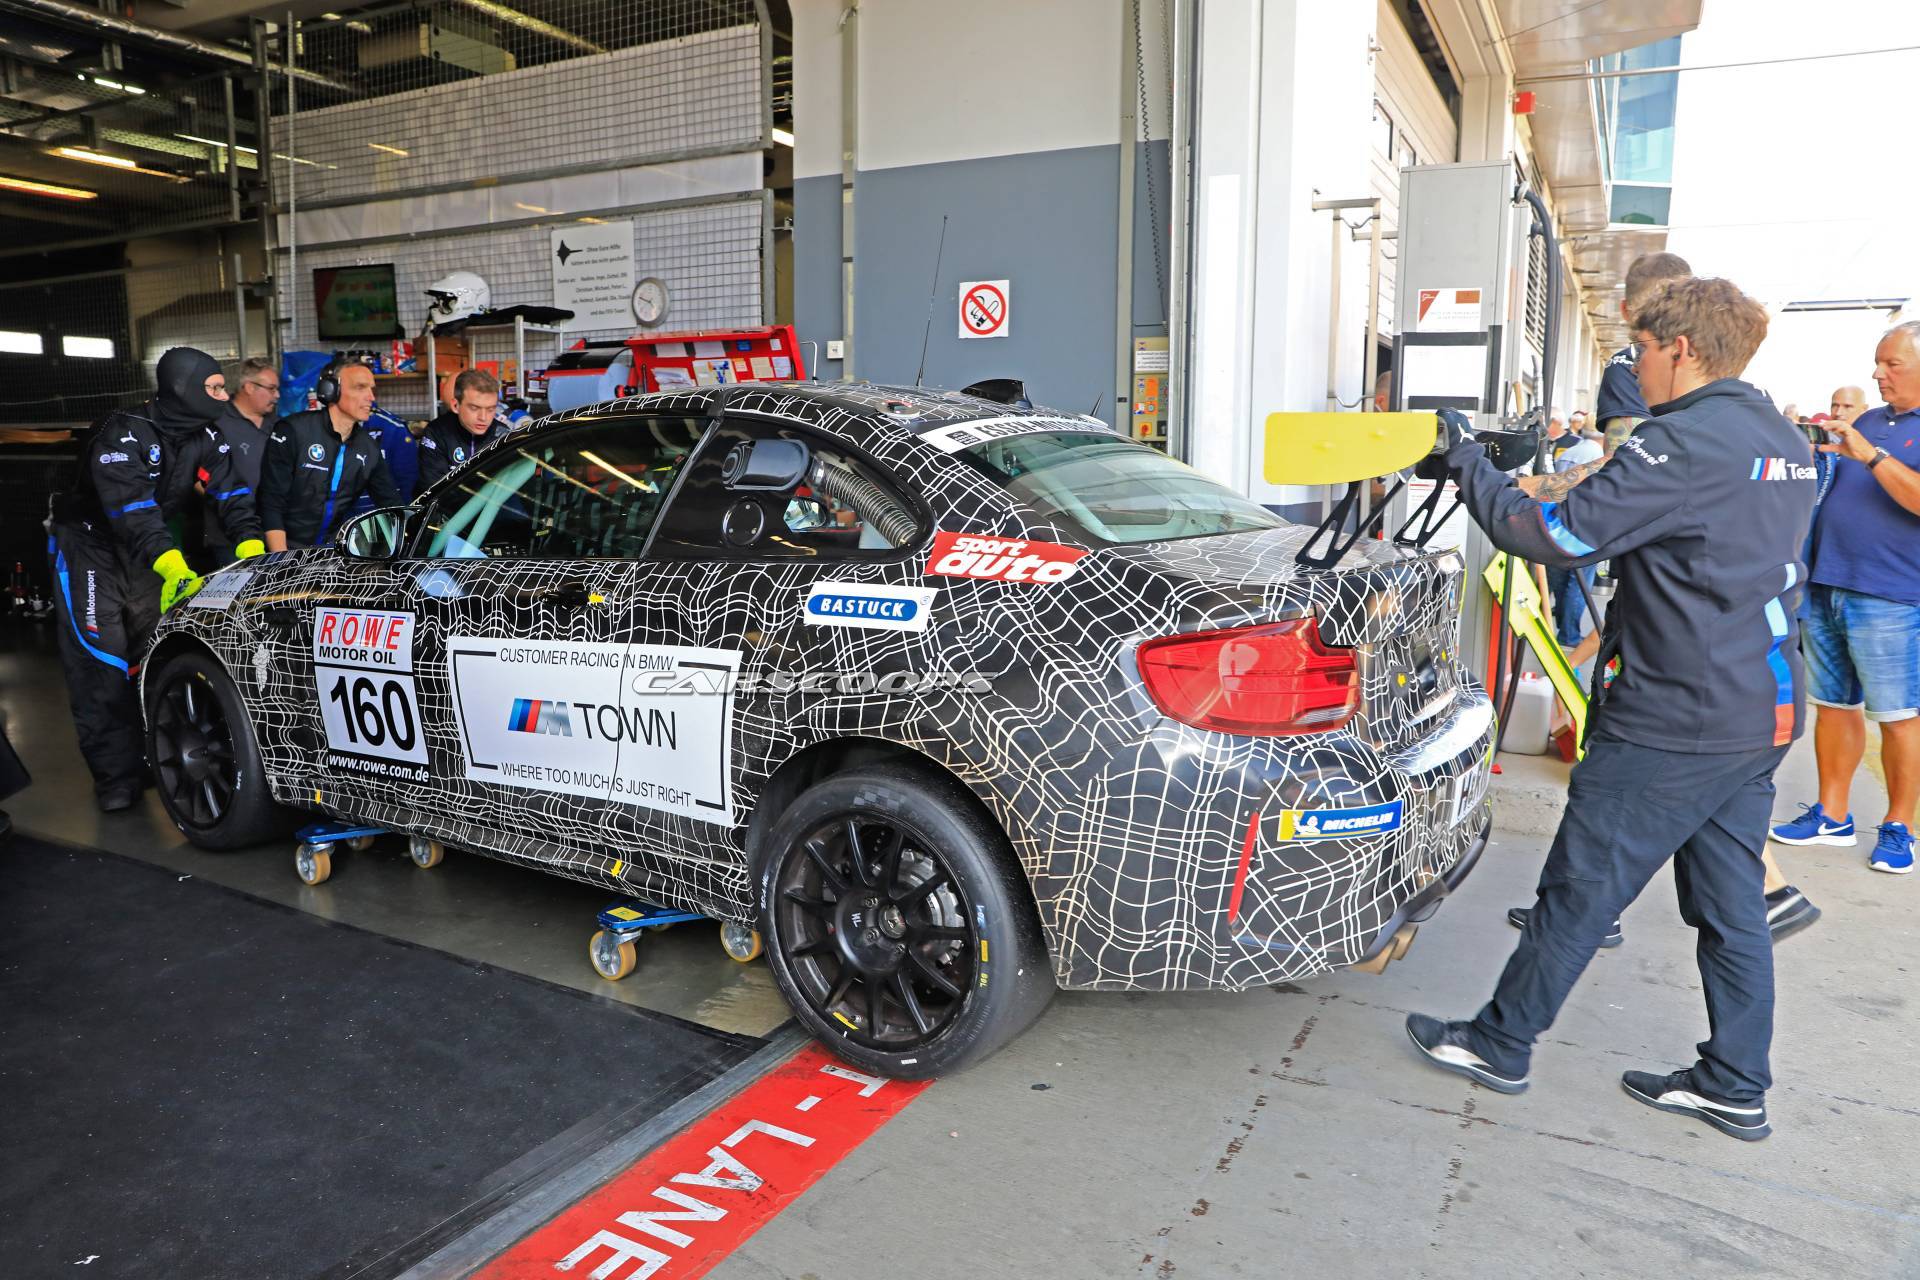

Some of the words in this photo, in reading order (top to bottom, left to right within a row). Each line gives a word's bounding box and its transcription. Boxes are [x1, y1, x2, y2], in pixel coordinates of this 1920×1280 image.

[951, 536, 1028, 556] sport
[934, 551, 1078, 583] auto
[86, 570, 96, 614] Motorsport
[820, 598, 906, 618] BASTUCK
[320, 614, 404, 650] ROWE
[319, 646, 368, 662] MOTOR
[373, 650, 396, 664] OIL
[500, 648, 568, 666] CUSTOMER
[571, 651, 619, 668] RACING
[622, 653, 636, 669] IN
[638, 655, 674, 670] BMW
[330, 676, 416, 752] 160
[574, 702, 676, 750] TOWN
[329, 754, 430, 782] www.rowe.com.de
[501, 762, 543, 781] WHERE
[544, 768, 571, 785] TOO
[574, 771, 610, 789] MUCH
[612, 777, 623, 792] IS
[626, 779, 655, 798] JUST
[658, 784, 691, 808] RIGHT
[1322, 812, 1394, 831] MICHELIN
[555, 1119, 817, 1280] LANE
